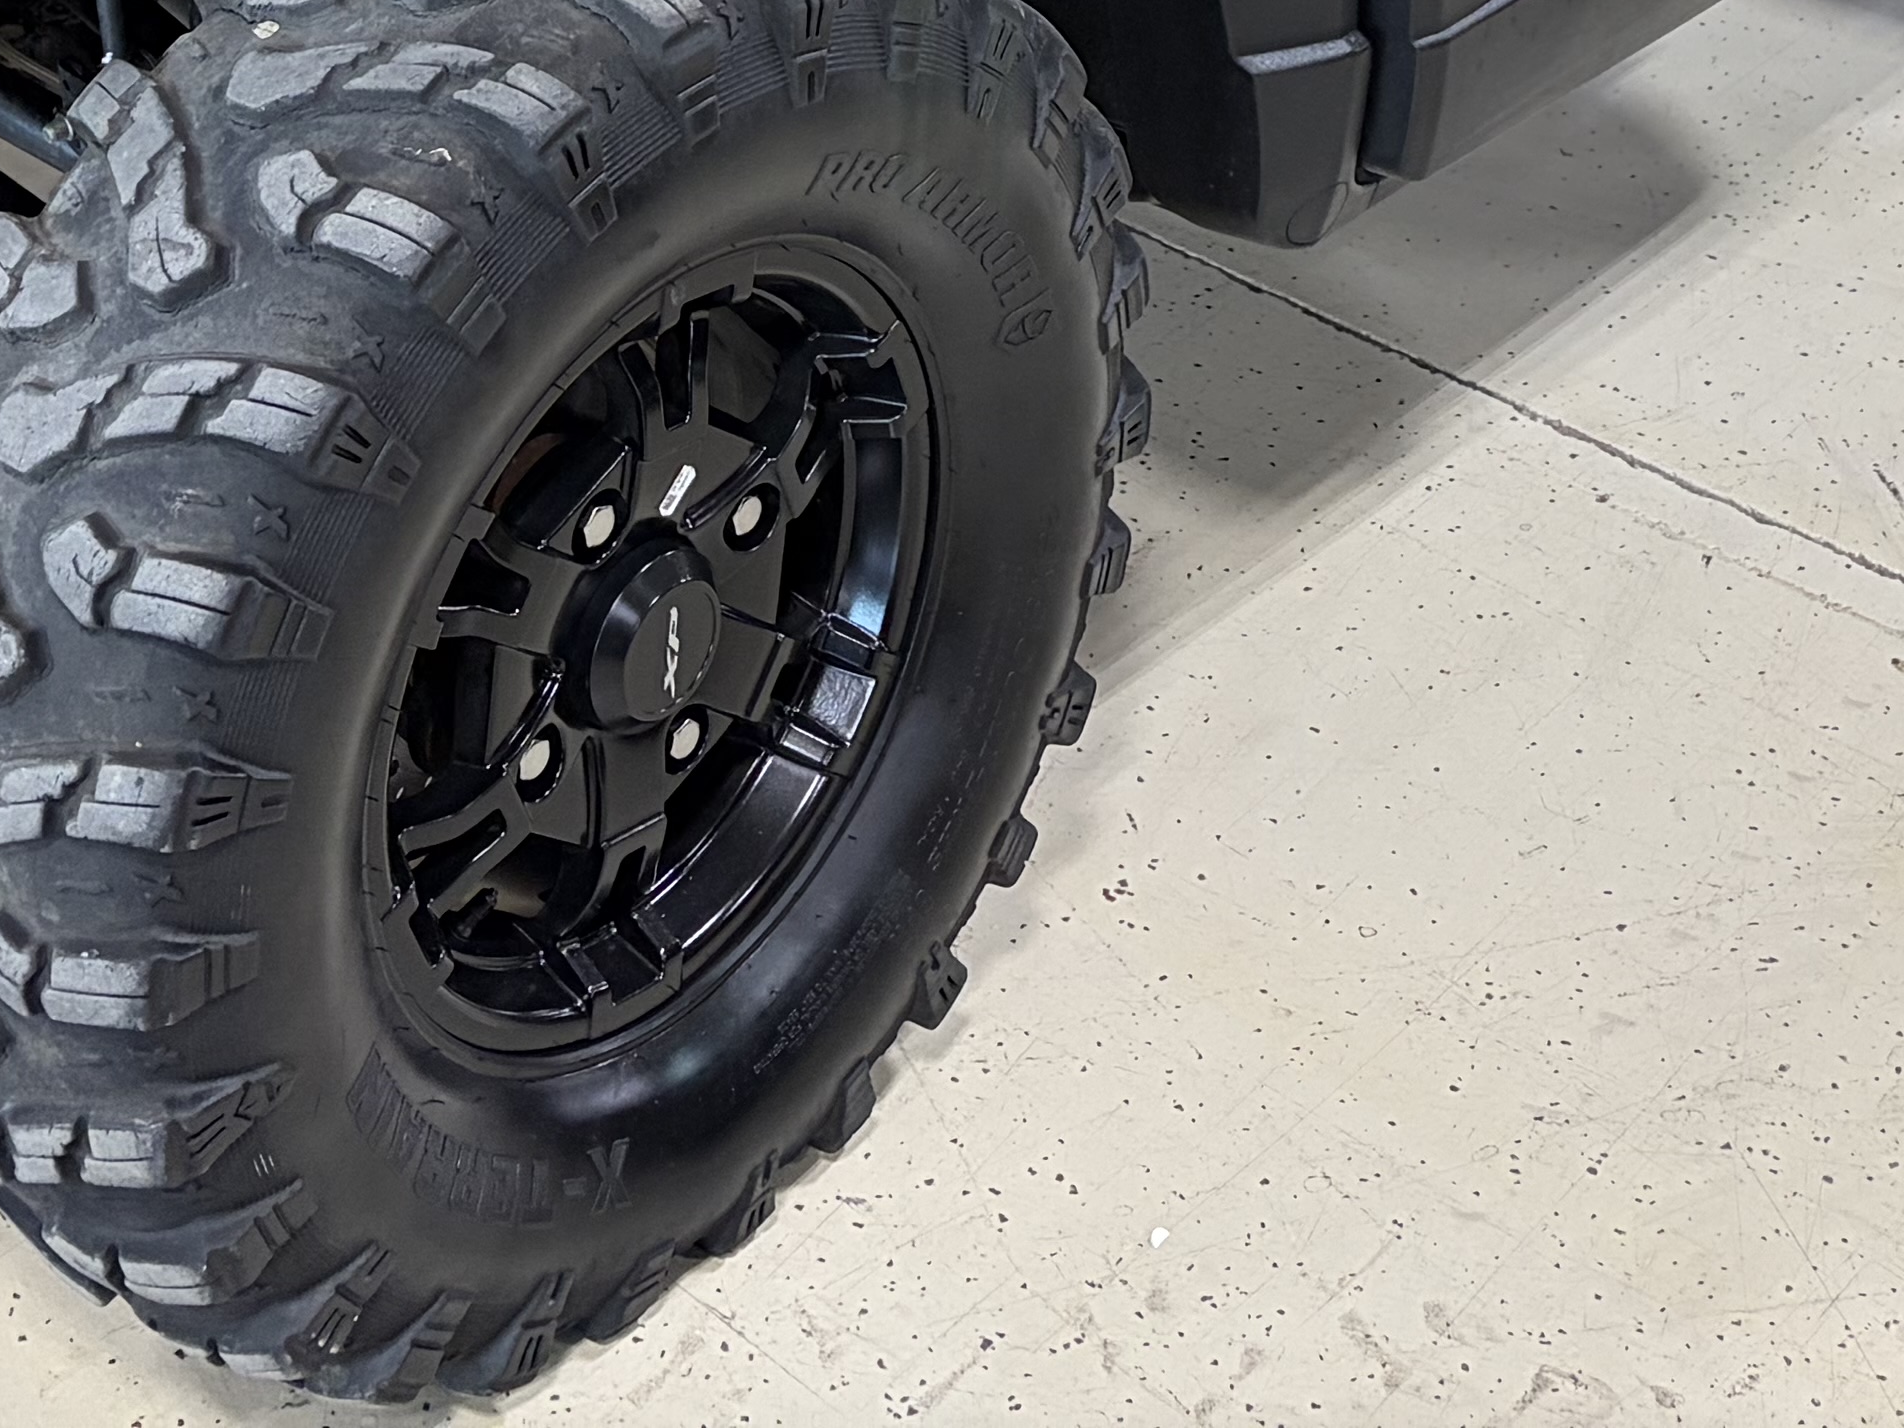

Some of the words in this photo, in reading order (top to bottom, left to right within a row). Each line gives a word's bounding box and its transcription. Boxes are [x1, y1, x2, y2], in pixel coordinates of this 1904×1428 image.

[804, 150, 910, 203] PRO
[900, 166, 1039, 308] ARMOR
[663, 605, 681, 698] XP
